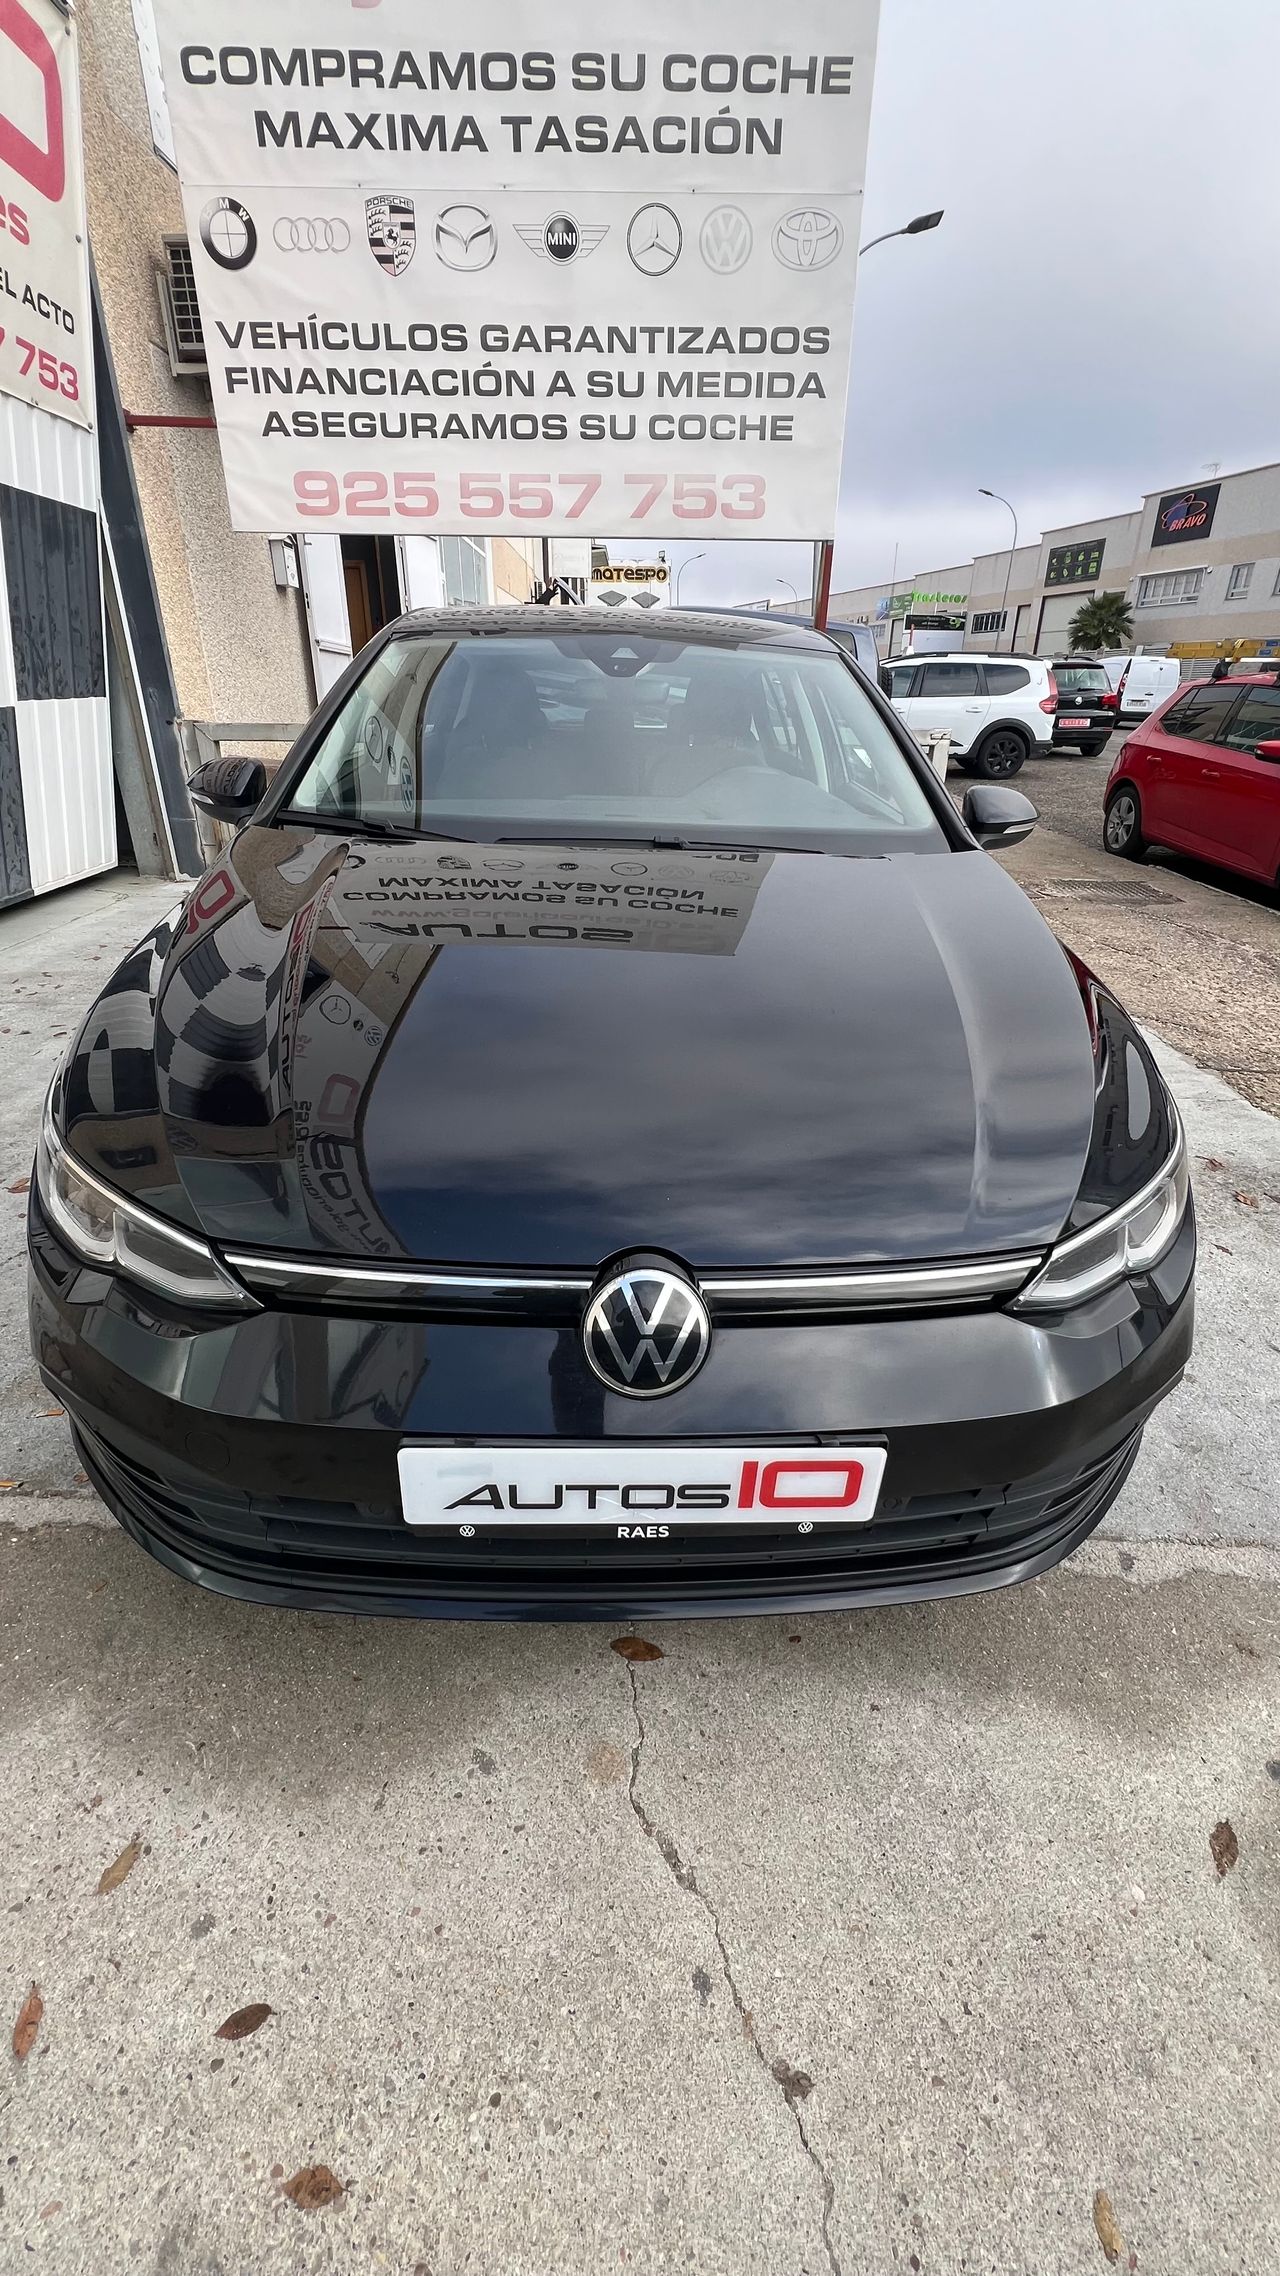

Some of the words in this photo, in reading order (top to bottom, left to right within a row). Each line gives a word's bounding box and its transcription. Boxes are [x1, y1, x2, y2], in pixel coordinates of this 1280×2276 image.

[180, 45, 556, 91] COMPRAMOS
[571, 52, 646, 91] SU
[662, 54, 855, 94] COCHE
[253, 110, 489, 153] MAXIMA
[500, 105, 783, 155] TASACIÓN
[365, 196, 414, 209] PORSCHE
[546, 231, 577, 247] MINI
[22, 283, 75, 335] ACTO
[214, 313, 468, 352] VEHÍCULOS
[480, 324, 831, 354] GARANTIZADOS
[15, 335, 79, 401] 753
[224, 361, 535, 397] FINANCIACIÓN
[546, 370, 576, 397] A
[587, 370, 645, 398] SU
[657, 371, 827, 399] MEDIDA
[261, 411, 568, 440] ASEGURAMOS
[579, 414, 637, 440] SU
[649, 414, 794, 441] COCHE
[293, 470, 439, 518] 925
[459, 472, 602, 519] 557
[624, 474, 767, 520] 753
[1168, 513, 1207, 532] BRAVO
[617, 1525, 670, 1539] RAES
